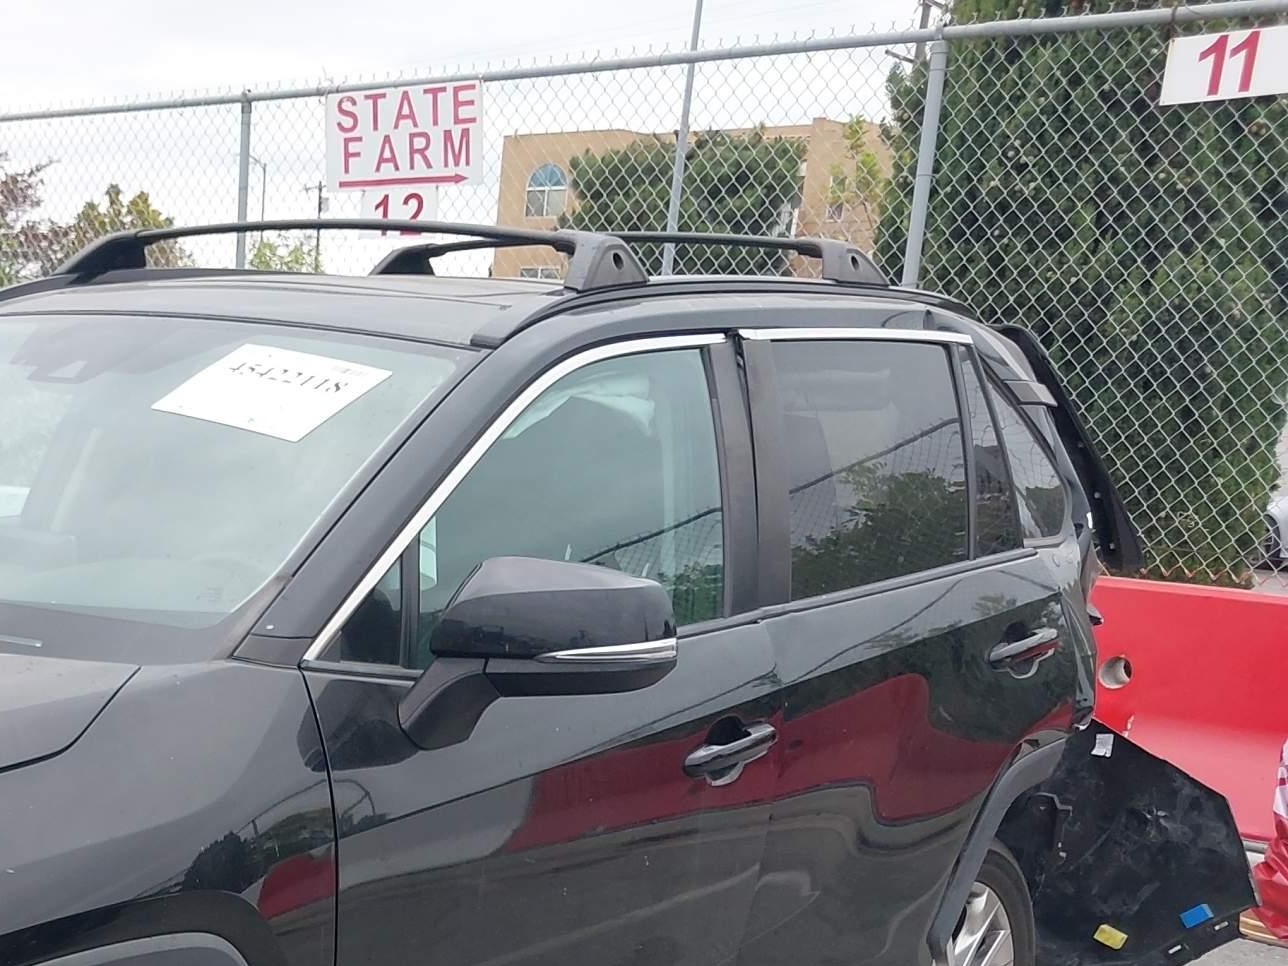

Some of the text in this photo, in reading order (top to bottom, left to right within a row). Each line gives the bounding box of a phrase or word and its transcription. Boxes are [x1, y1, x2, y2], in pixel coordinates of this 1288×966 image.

[1198, 30, 1261, 97] 11
[336, 84, 477, 133] STATE
[343, 128, 470, 174] FARM
[374, 192, 424, 236] 12
